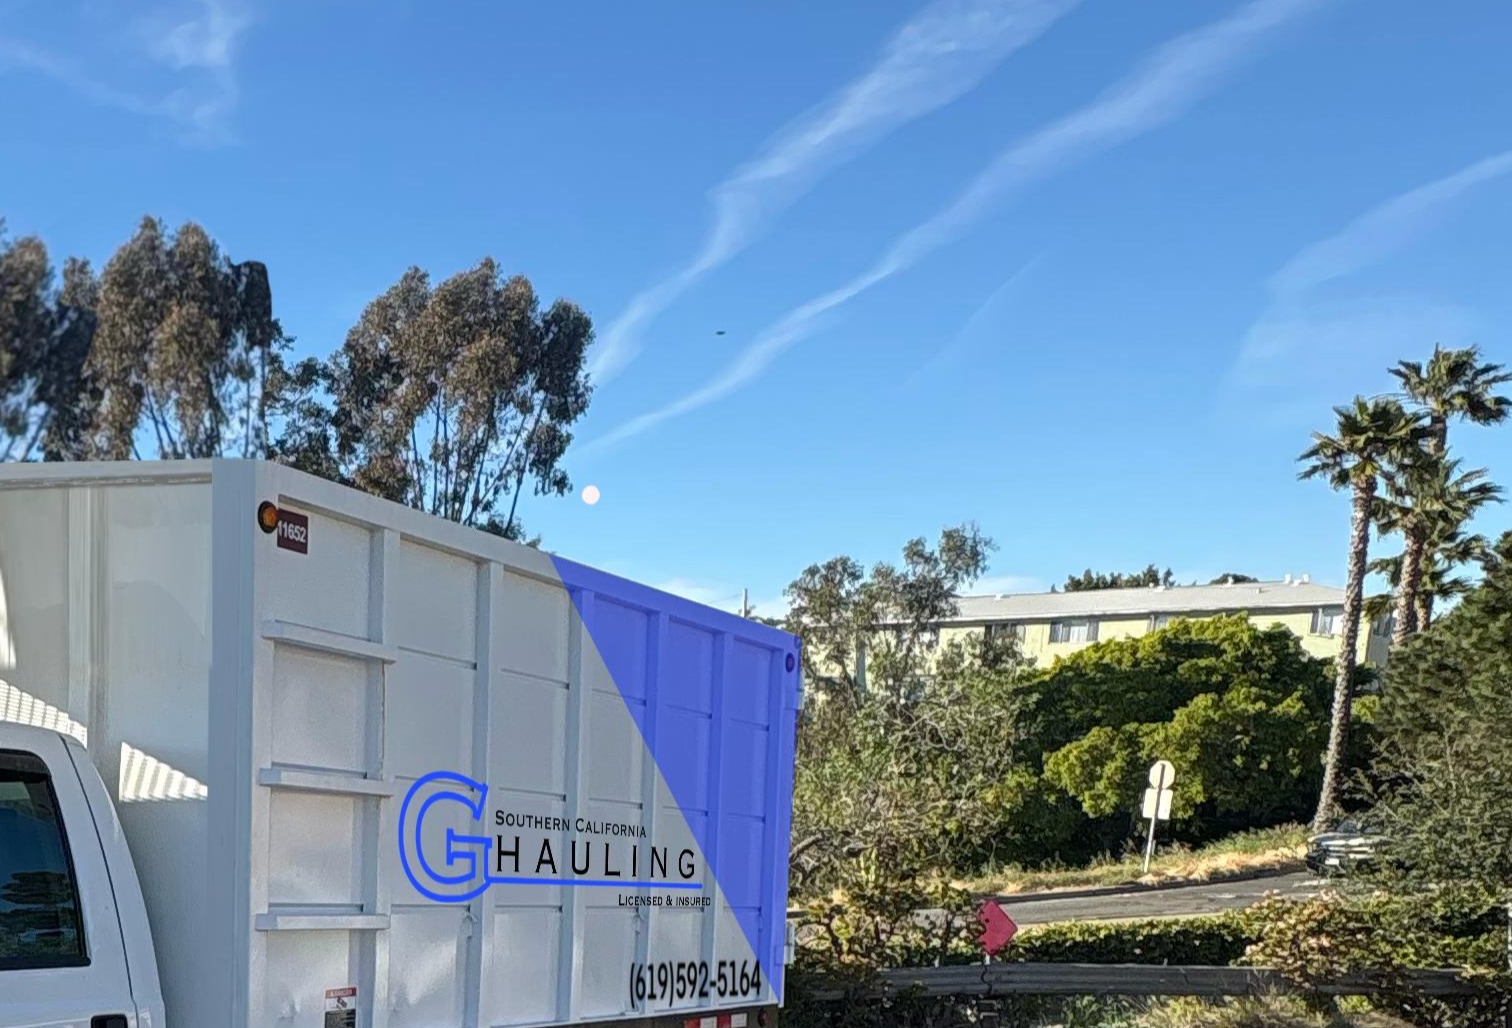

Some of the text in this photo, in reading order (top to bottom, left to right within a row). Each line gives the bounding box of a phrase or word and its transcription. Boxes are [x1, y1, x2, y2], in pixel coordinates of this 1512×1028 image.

[278, 519, 307, 543] 11652
[496, 835, 696, 879] HAULING
[665, 894, 673, 907] &
[629, 959, 761, 1009] (619)592-5164
